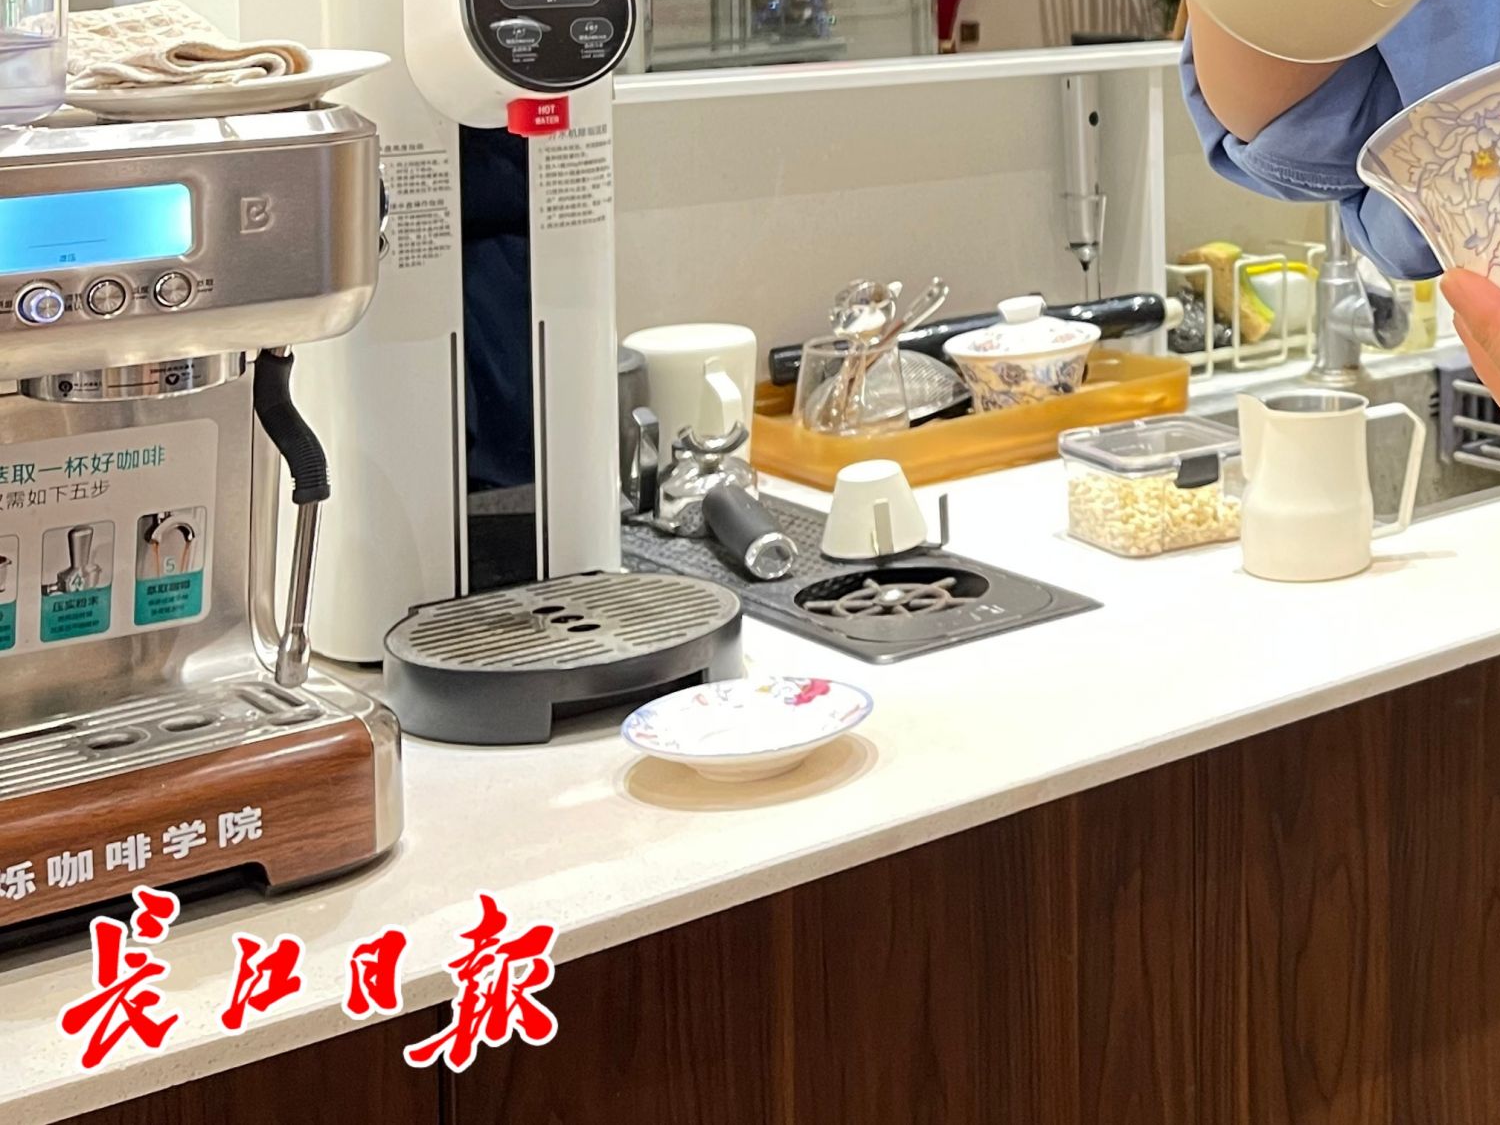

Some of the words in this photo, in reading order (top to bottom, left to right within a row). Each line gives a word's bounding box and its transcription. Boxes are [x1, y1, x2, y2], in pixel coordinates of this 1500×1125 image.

[538, 104, 556, 115] HOT
[535, 115, 560, 125] WATER
[0, 479, 110, 511] 需如下五步
